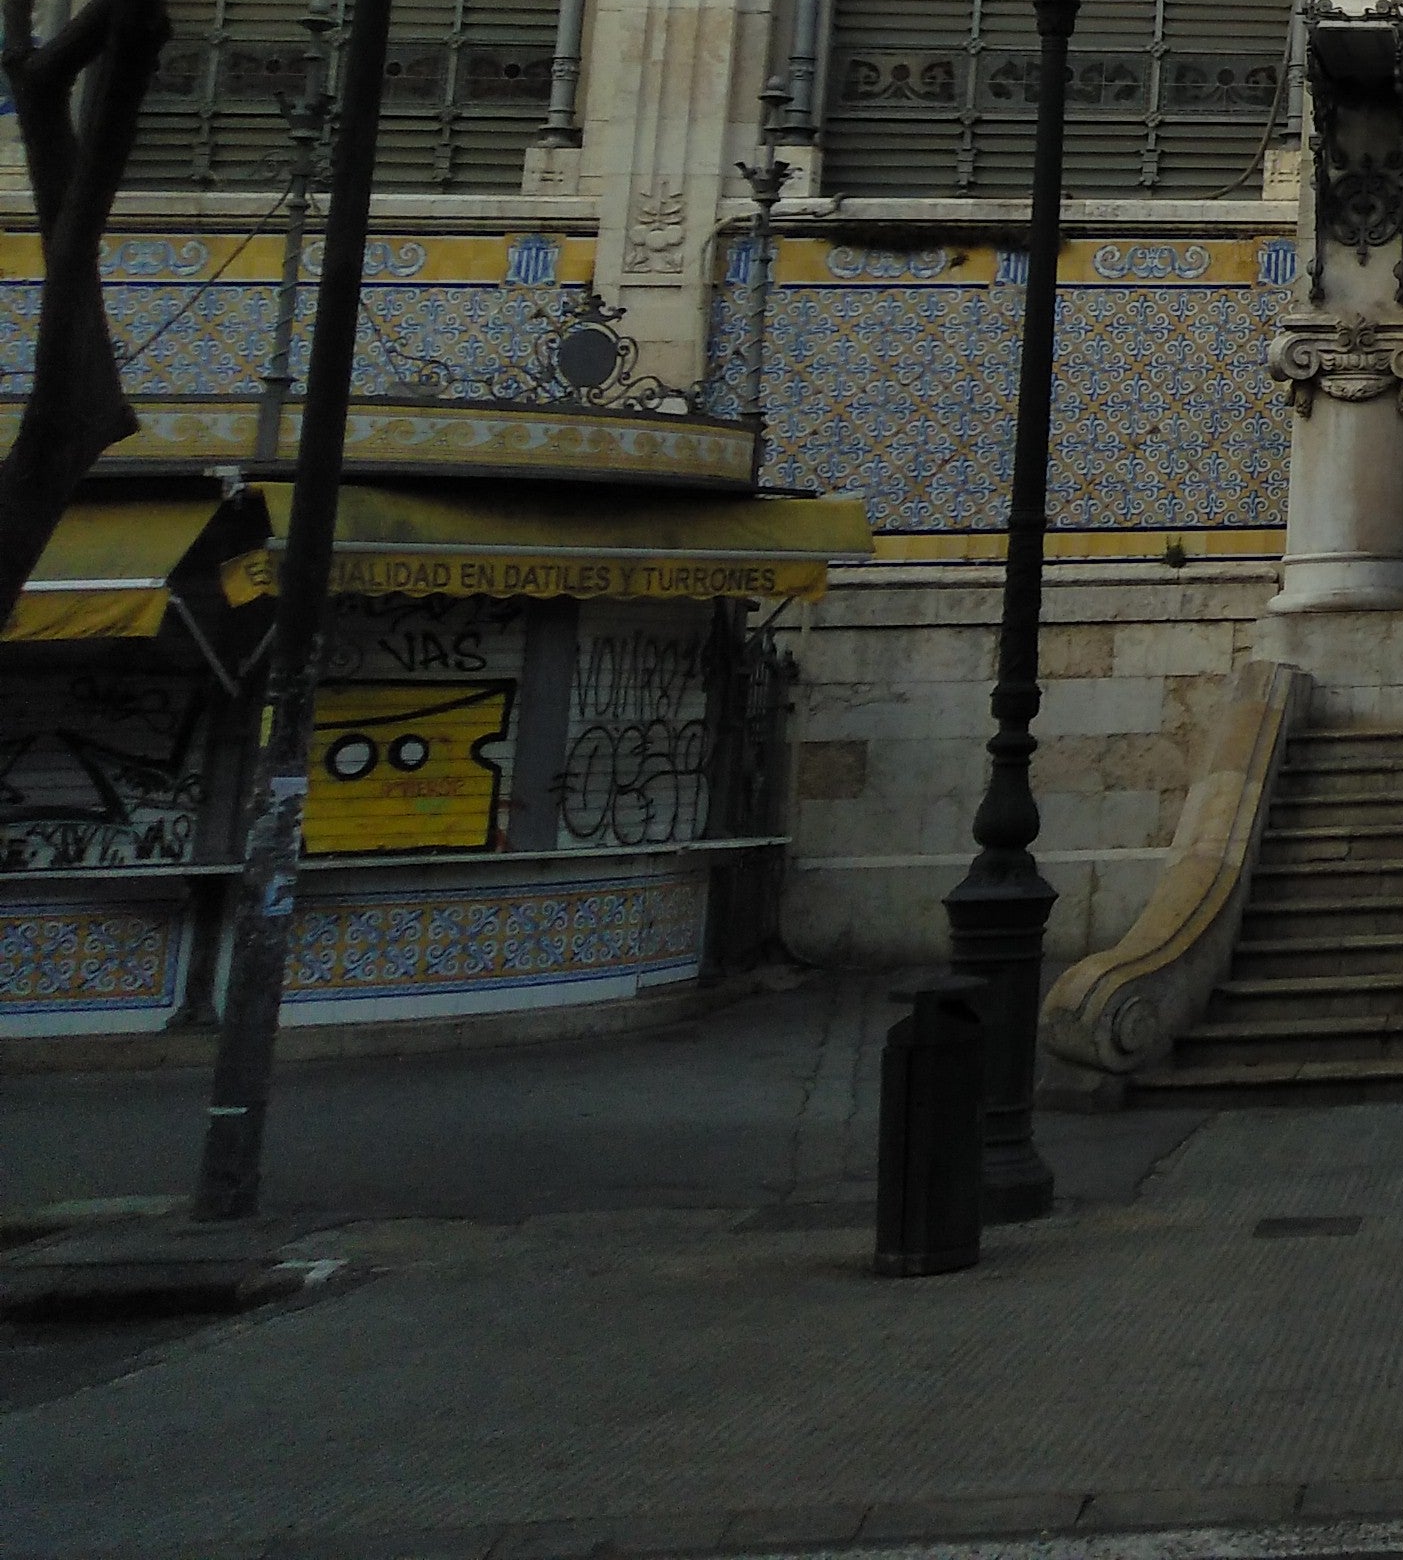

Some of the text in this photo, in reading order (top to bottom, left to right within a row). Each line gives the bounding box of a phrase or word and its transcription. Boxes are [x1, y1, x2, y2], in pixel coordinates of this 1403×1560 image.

[460, 563, 495, 589] EN
[503, 564, 610, 590] DATILES
[622, 566, 637, 591] Y
[642, 566, 776, 591] TURRONES
